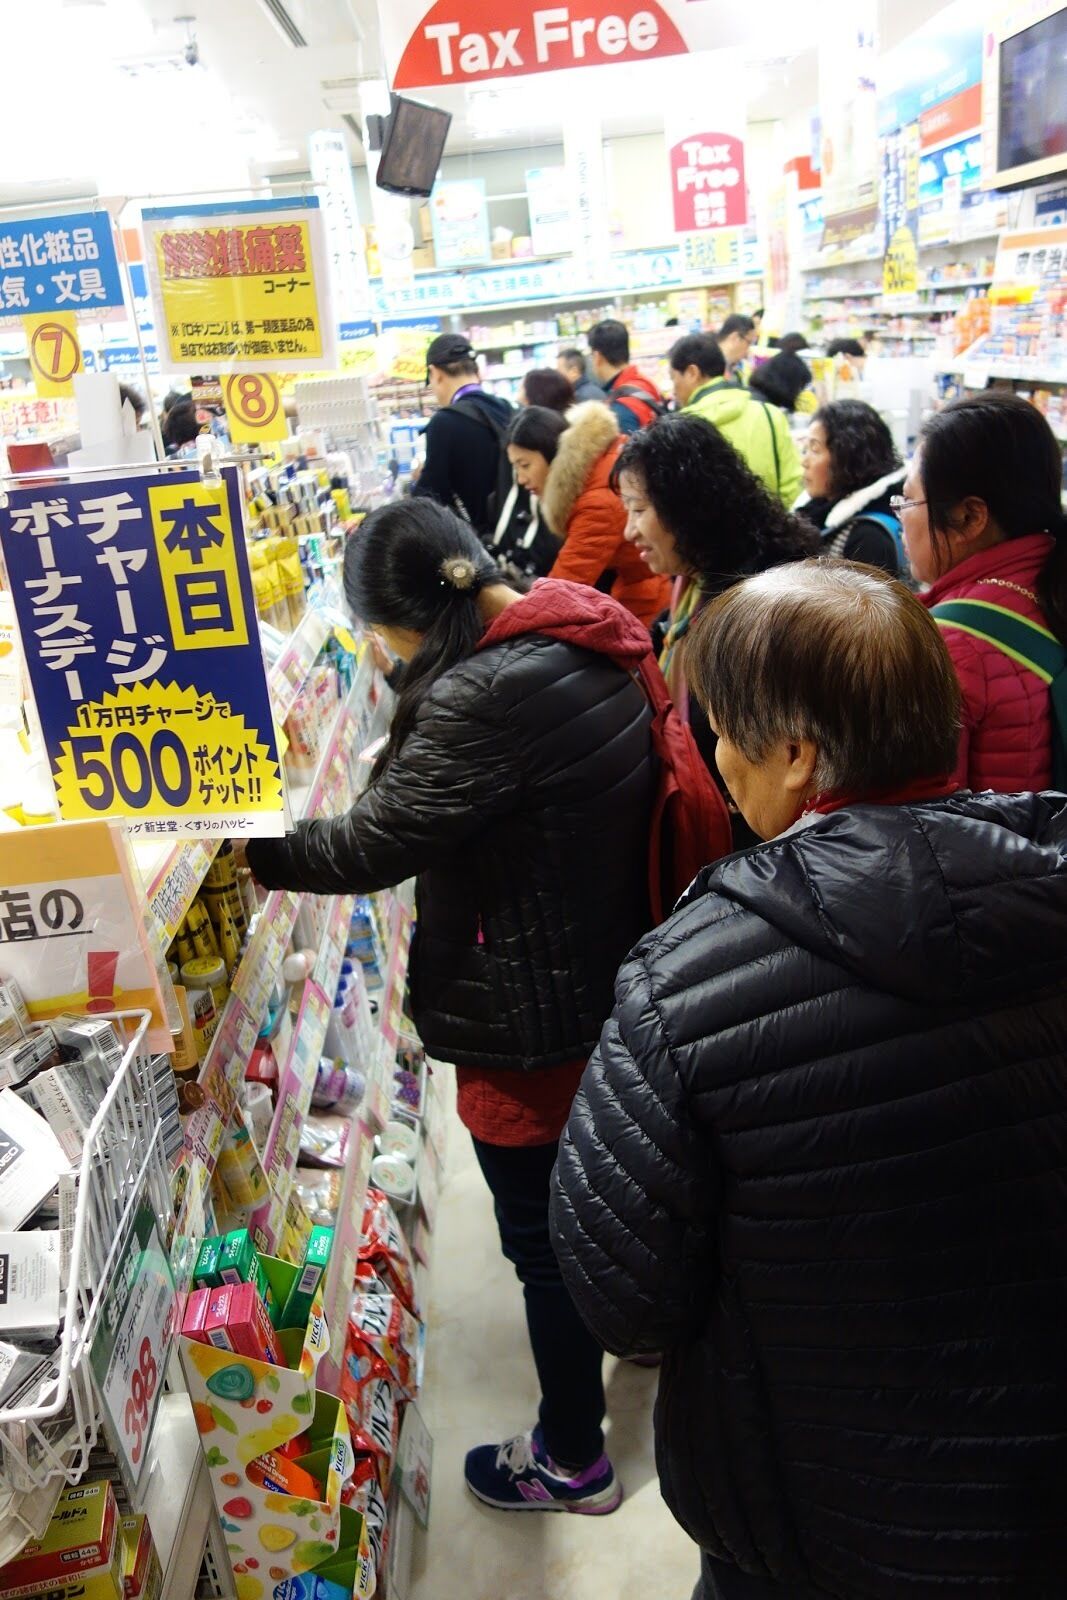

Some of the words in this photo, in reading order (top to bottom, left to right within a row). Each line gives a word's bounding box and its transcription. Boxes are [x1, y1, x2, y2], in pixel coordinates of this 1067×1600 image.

[425, 23, 523, 76] Tax
[532, 7, 659, 63] Free
[682, 141, 732, 166] Tax
[677, 166, 740, 192] Free
[0, 268, 106, 309] 気・文具
[263, 277, 311, 294] コーナー
[160, 498, 235, 636] 本日
[10, 497, 97, 700] ボーナスデー
[78, 491, 168, 685] チャージ
[80, 699, 230, 729] 1万円チャージで
[71, 729, 192, 811] 500
[193, 743, 258, 776] ポイント
[199, 778, 261, 806] ゲット!!
[310, 1315, 322, 1345] VICKS
[124, 1336, 157, 1465] 398
[335, 1441, 346, 1472] VICKS
[360, 1556, 369, 1590] VICKS
